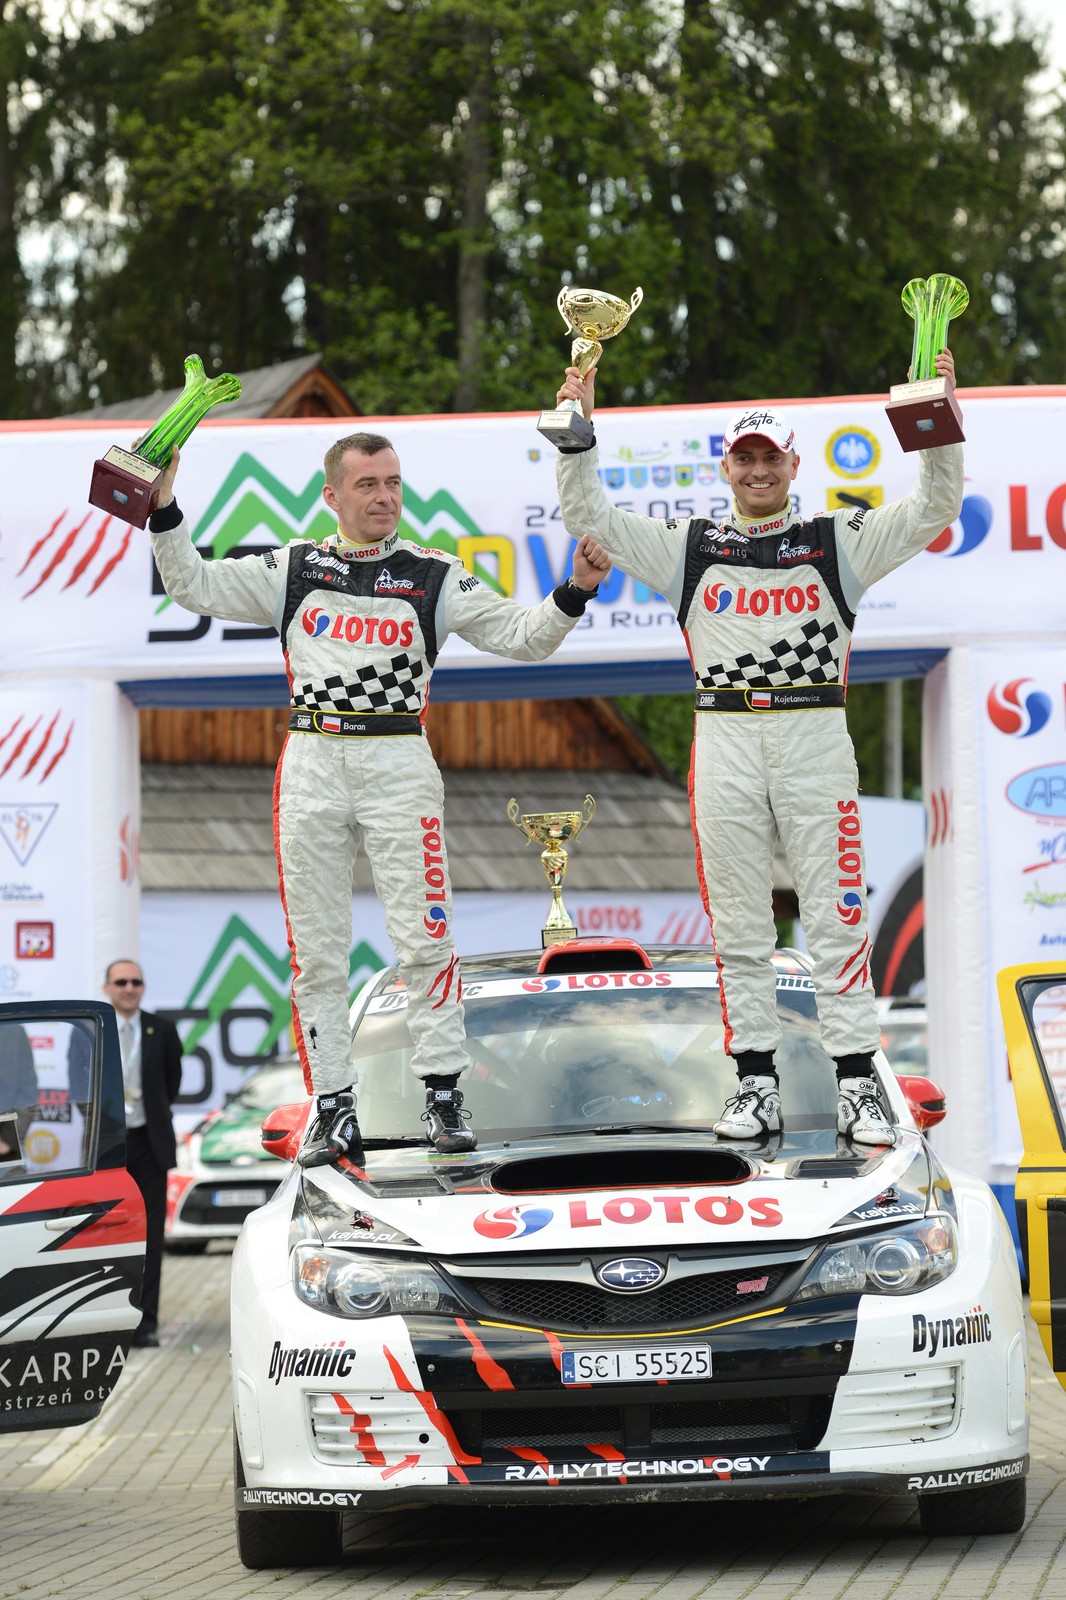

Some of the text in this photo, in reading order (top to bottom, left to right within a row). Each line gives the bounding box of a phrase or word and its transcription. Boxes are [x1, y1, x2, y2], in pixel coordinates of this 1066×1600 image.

[759, 518, 785, 534] LOTOS
[353, 546, 381, 560] LOTOS
[735, 583, 821, 617] LOTOS
[330, 614, 415, 648] LOTOS
[699, 695, 821, 706] OMP Kajetanowicz
[297, 717, 366, 731] OMP Baran
[837, 800, 862, 887] LOTOS
[420, 816, 446, 902] LOTOS
[576, 906, 643, 932] LOTOS
[567, 973, 672, 990] LOTOS
[741, 1080, 756, 1091] OMP
[858, 1082, 875, 1092] OMP
[319, 1099, 337, 1109] OMP
[434, 1092, 452, 1101] OMP
[569, 1196, 784, 1229] LOTOS
[853, 1202, 921, 1220] kajto.pl
[328, 1229, 399, 1243] kajto.pl
[911, 1305, 992, 1358] Dynamic
[268, 1341, 357, 1386] Dynamic
[564, 1350, 709, 1379] PL SCI 55525
[0, 1387, 72, 1411] strzeń
[505, 1455, 772, 1481] RALLYTECHNOLOGY
[907, 1460, 1024, 1491] RALLYTECHNOLOGY
[243, 1490, 363, 1507] RALLYTECHNOLOGY
